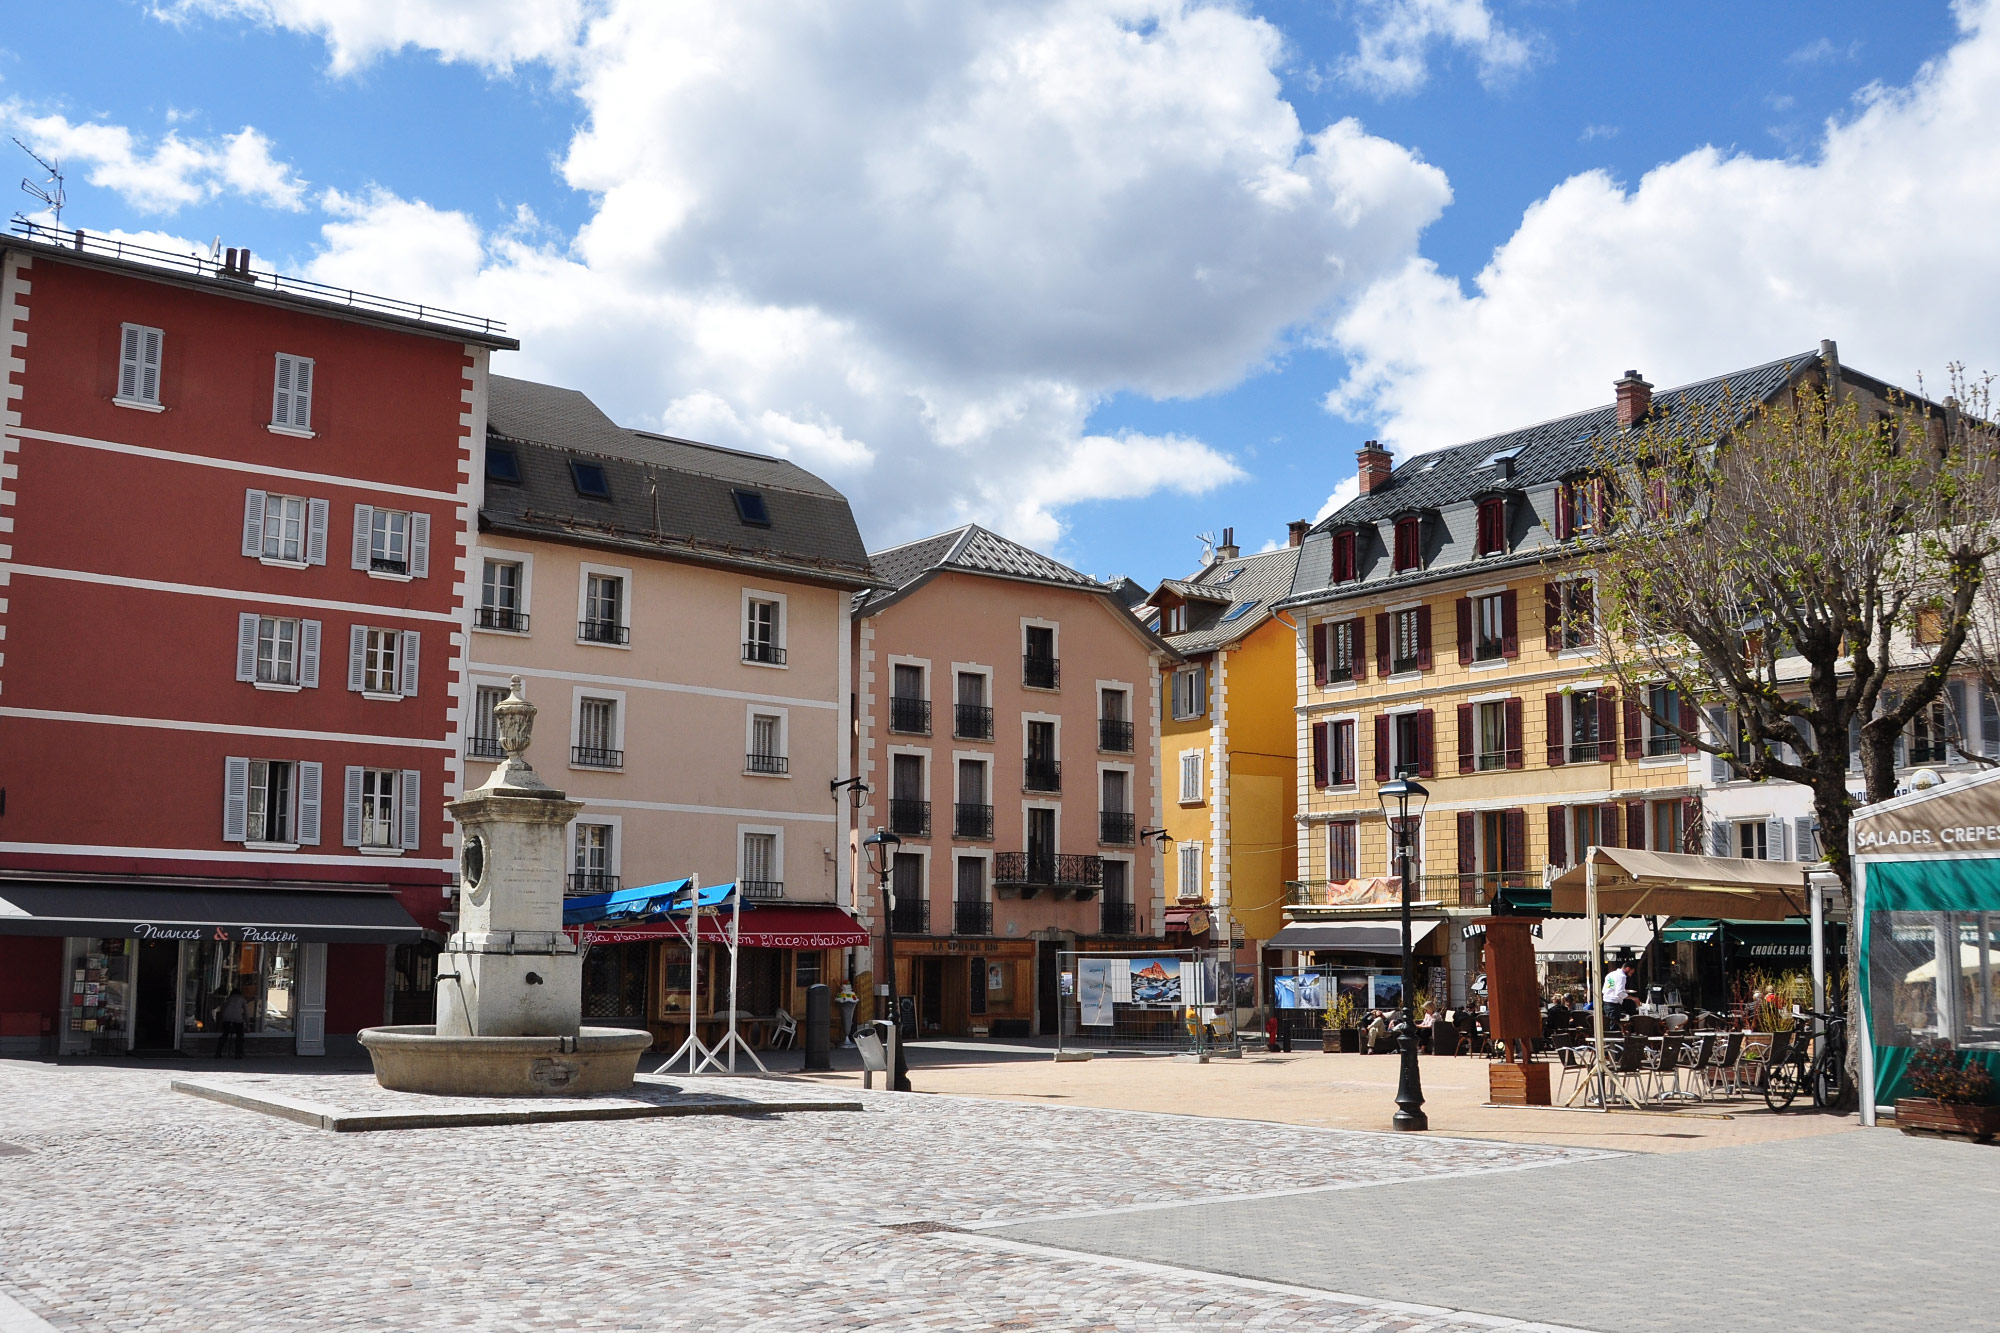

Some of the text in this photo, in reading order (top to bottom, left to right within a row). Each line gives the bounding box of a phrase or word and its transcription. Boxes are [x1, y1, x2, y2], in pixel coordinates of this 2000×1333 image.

[134, 923, 299, 942] Nuances & Passion
[760, 934, 809, 947] Glaces
[810, 934, 863, 946] Maison
